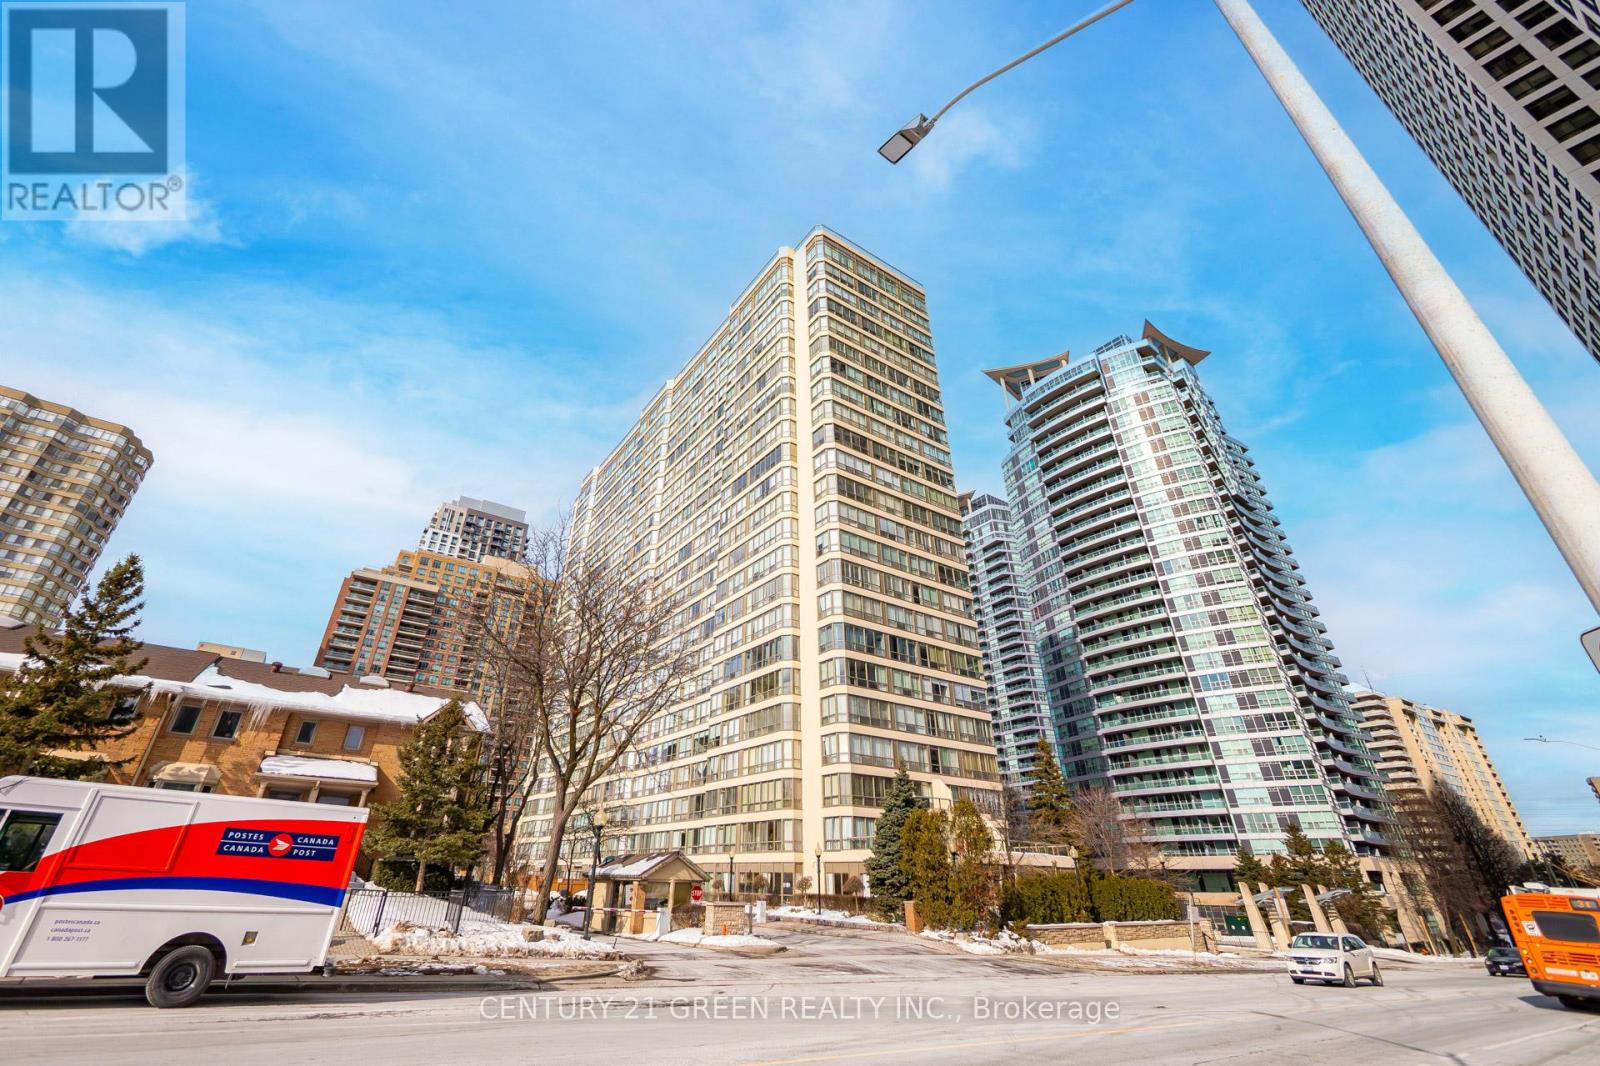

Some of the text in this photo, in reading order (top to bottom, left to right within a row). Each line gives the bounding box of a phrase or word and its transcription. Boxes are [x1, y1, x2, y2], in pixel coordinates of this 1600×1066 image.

[227, 831, 334, 846] POSTES CANADA
[223, 844, 316, 857] CANADA POST
[691, 889, 703, 897] STOP
